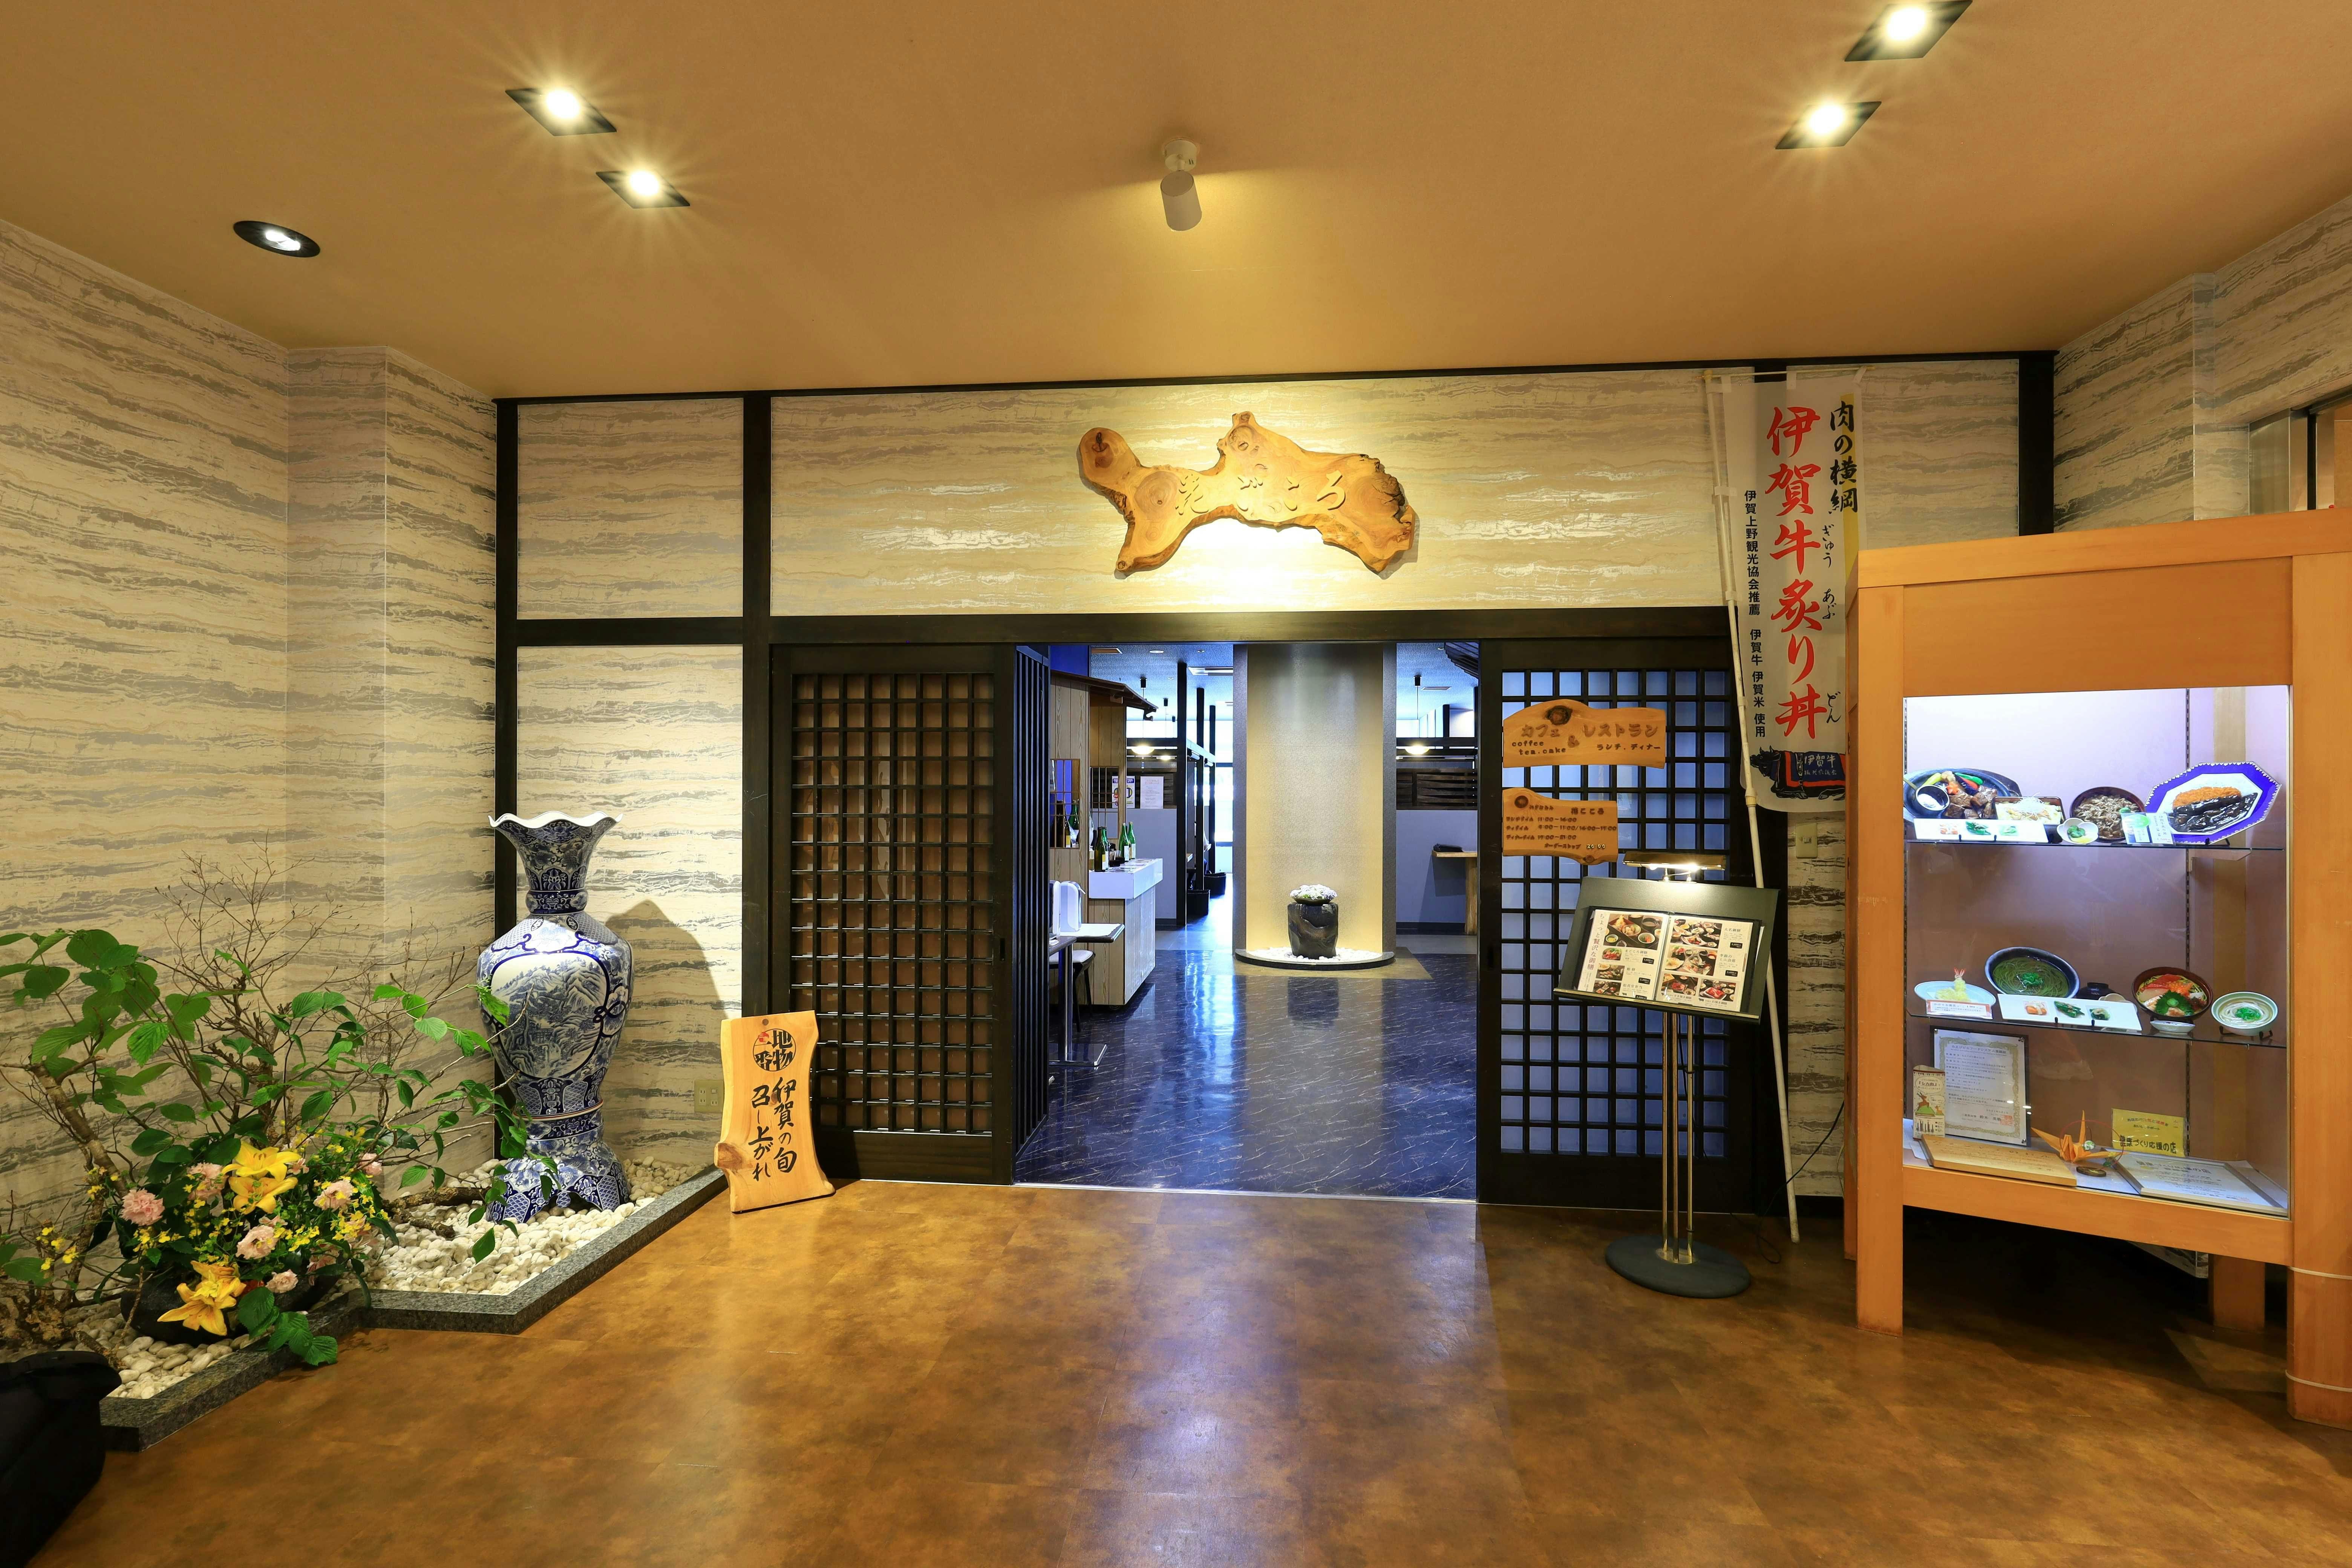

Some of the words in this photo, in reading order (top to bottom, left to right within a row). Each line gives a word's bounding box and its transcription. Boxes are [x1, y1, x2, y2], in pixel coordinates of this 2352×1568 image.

[1828, 401, 1858, 514] 肉の横綱
[1744, 490, 1760, 616] 伊賀上野観光協会推薦
[1822, 524, 1834, 568] ぎゅう
[1765, 406, 1827, 739] 伊賀牛炙り丼
[1822, 589, 1835, 620] あぶ
[1750, 629, 1763, 666] 伊賀牛
[1752, 671, 1764, 707] 伊賀米
[1826, 691, 1841, 723] どん
[1521, 723, 1560, 738] カフェ
[1568, 735, 1580, 748] &
[1583, 723, 1658, 738] レストラン
[1754, 713, 1766, 737] 使用
[1804, 754, 1836, 768] 伊賀牛
[748, 1084, 773, 1182] 召し上がれ
[773, 1076, 797, 1173] 伊賀の旬
[2119, 1135, 2177, 1154] 健康づくり応援の店
